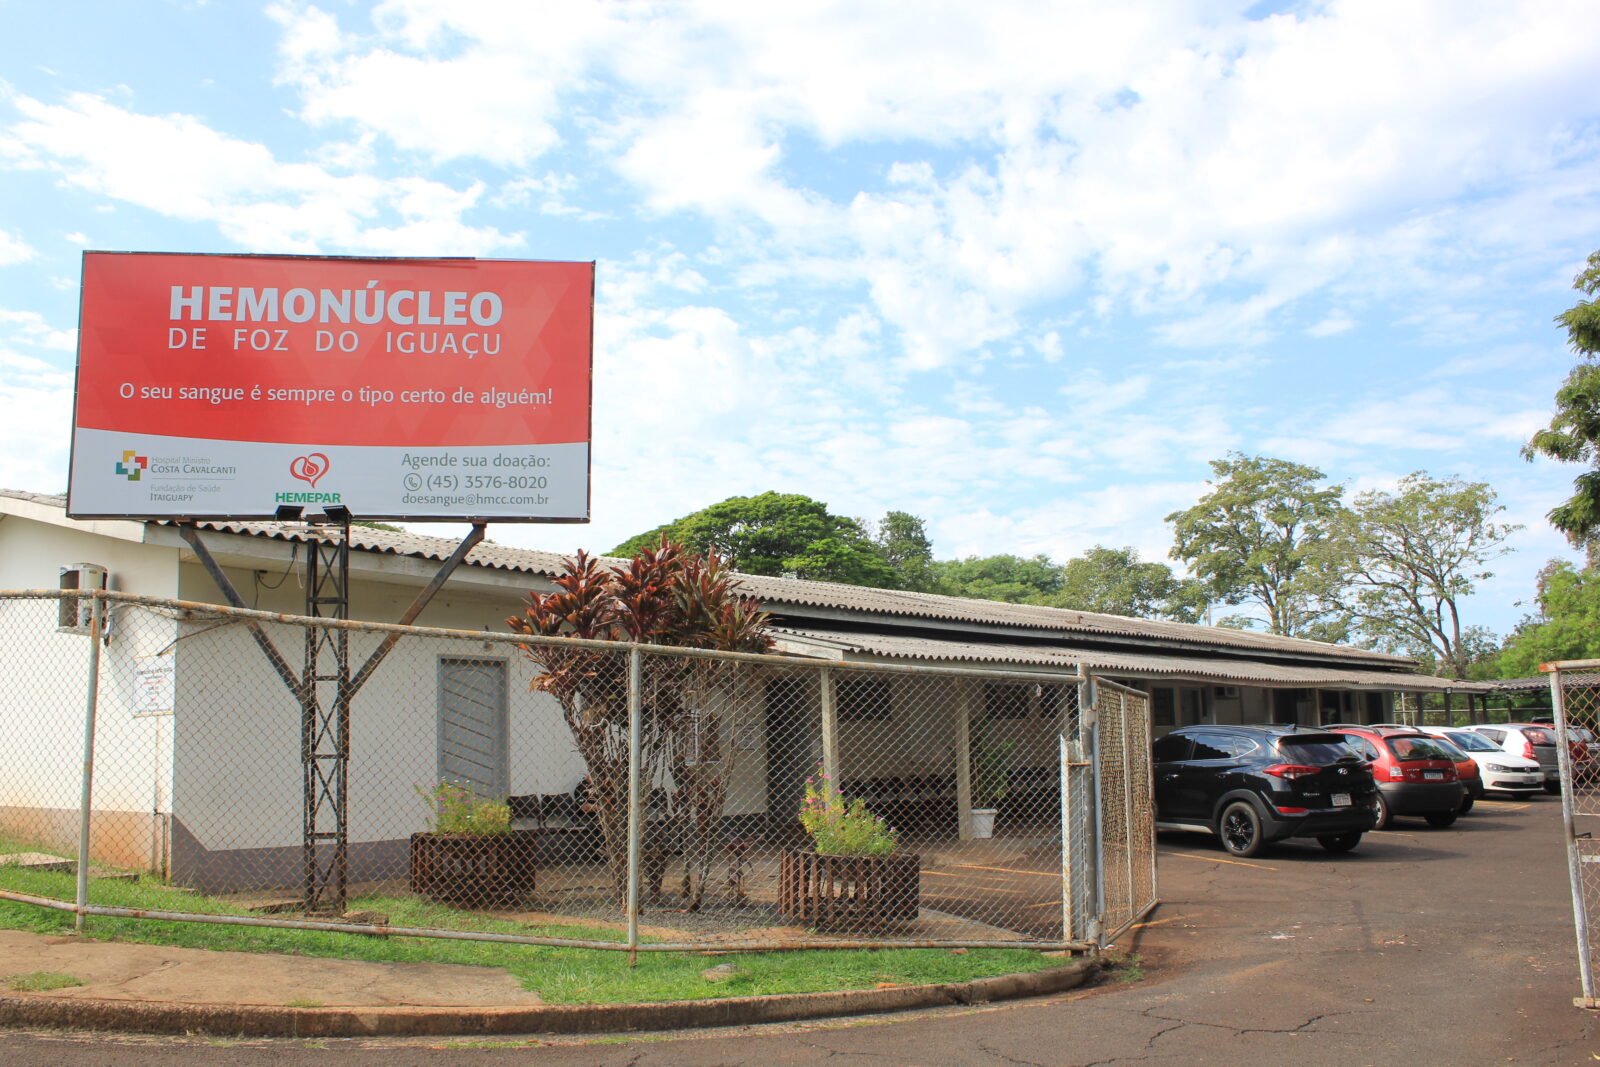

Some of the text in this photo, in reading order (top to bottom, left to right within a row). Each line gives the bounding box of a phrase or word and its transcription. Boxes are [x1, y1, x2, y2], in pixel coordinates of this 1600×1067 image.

[170, 280, 502, 326] HEMONÚCLEO
[168, 327, 500, 359] DE FOZ DO IGUAÇU
[119, 383, 553, 408] O seu sangue é sempre o tipo certo de alguém!
[152, 457, 211, 465] Hospital Ministro
[401, 453, 551, 470] Agende sua doação:
[150, 484, 222, 493] Fundação de Saúde
[426, 474, 548, 491] (45) 3576-8020
[275, 492, 342, 503] HEMEPAR
[402, 493, 550, 507] doesangue@hmcc.com.br
